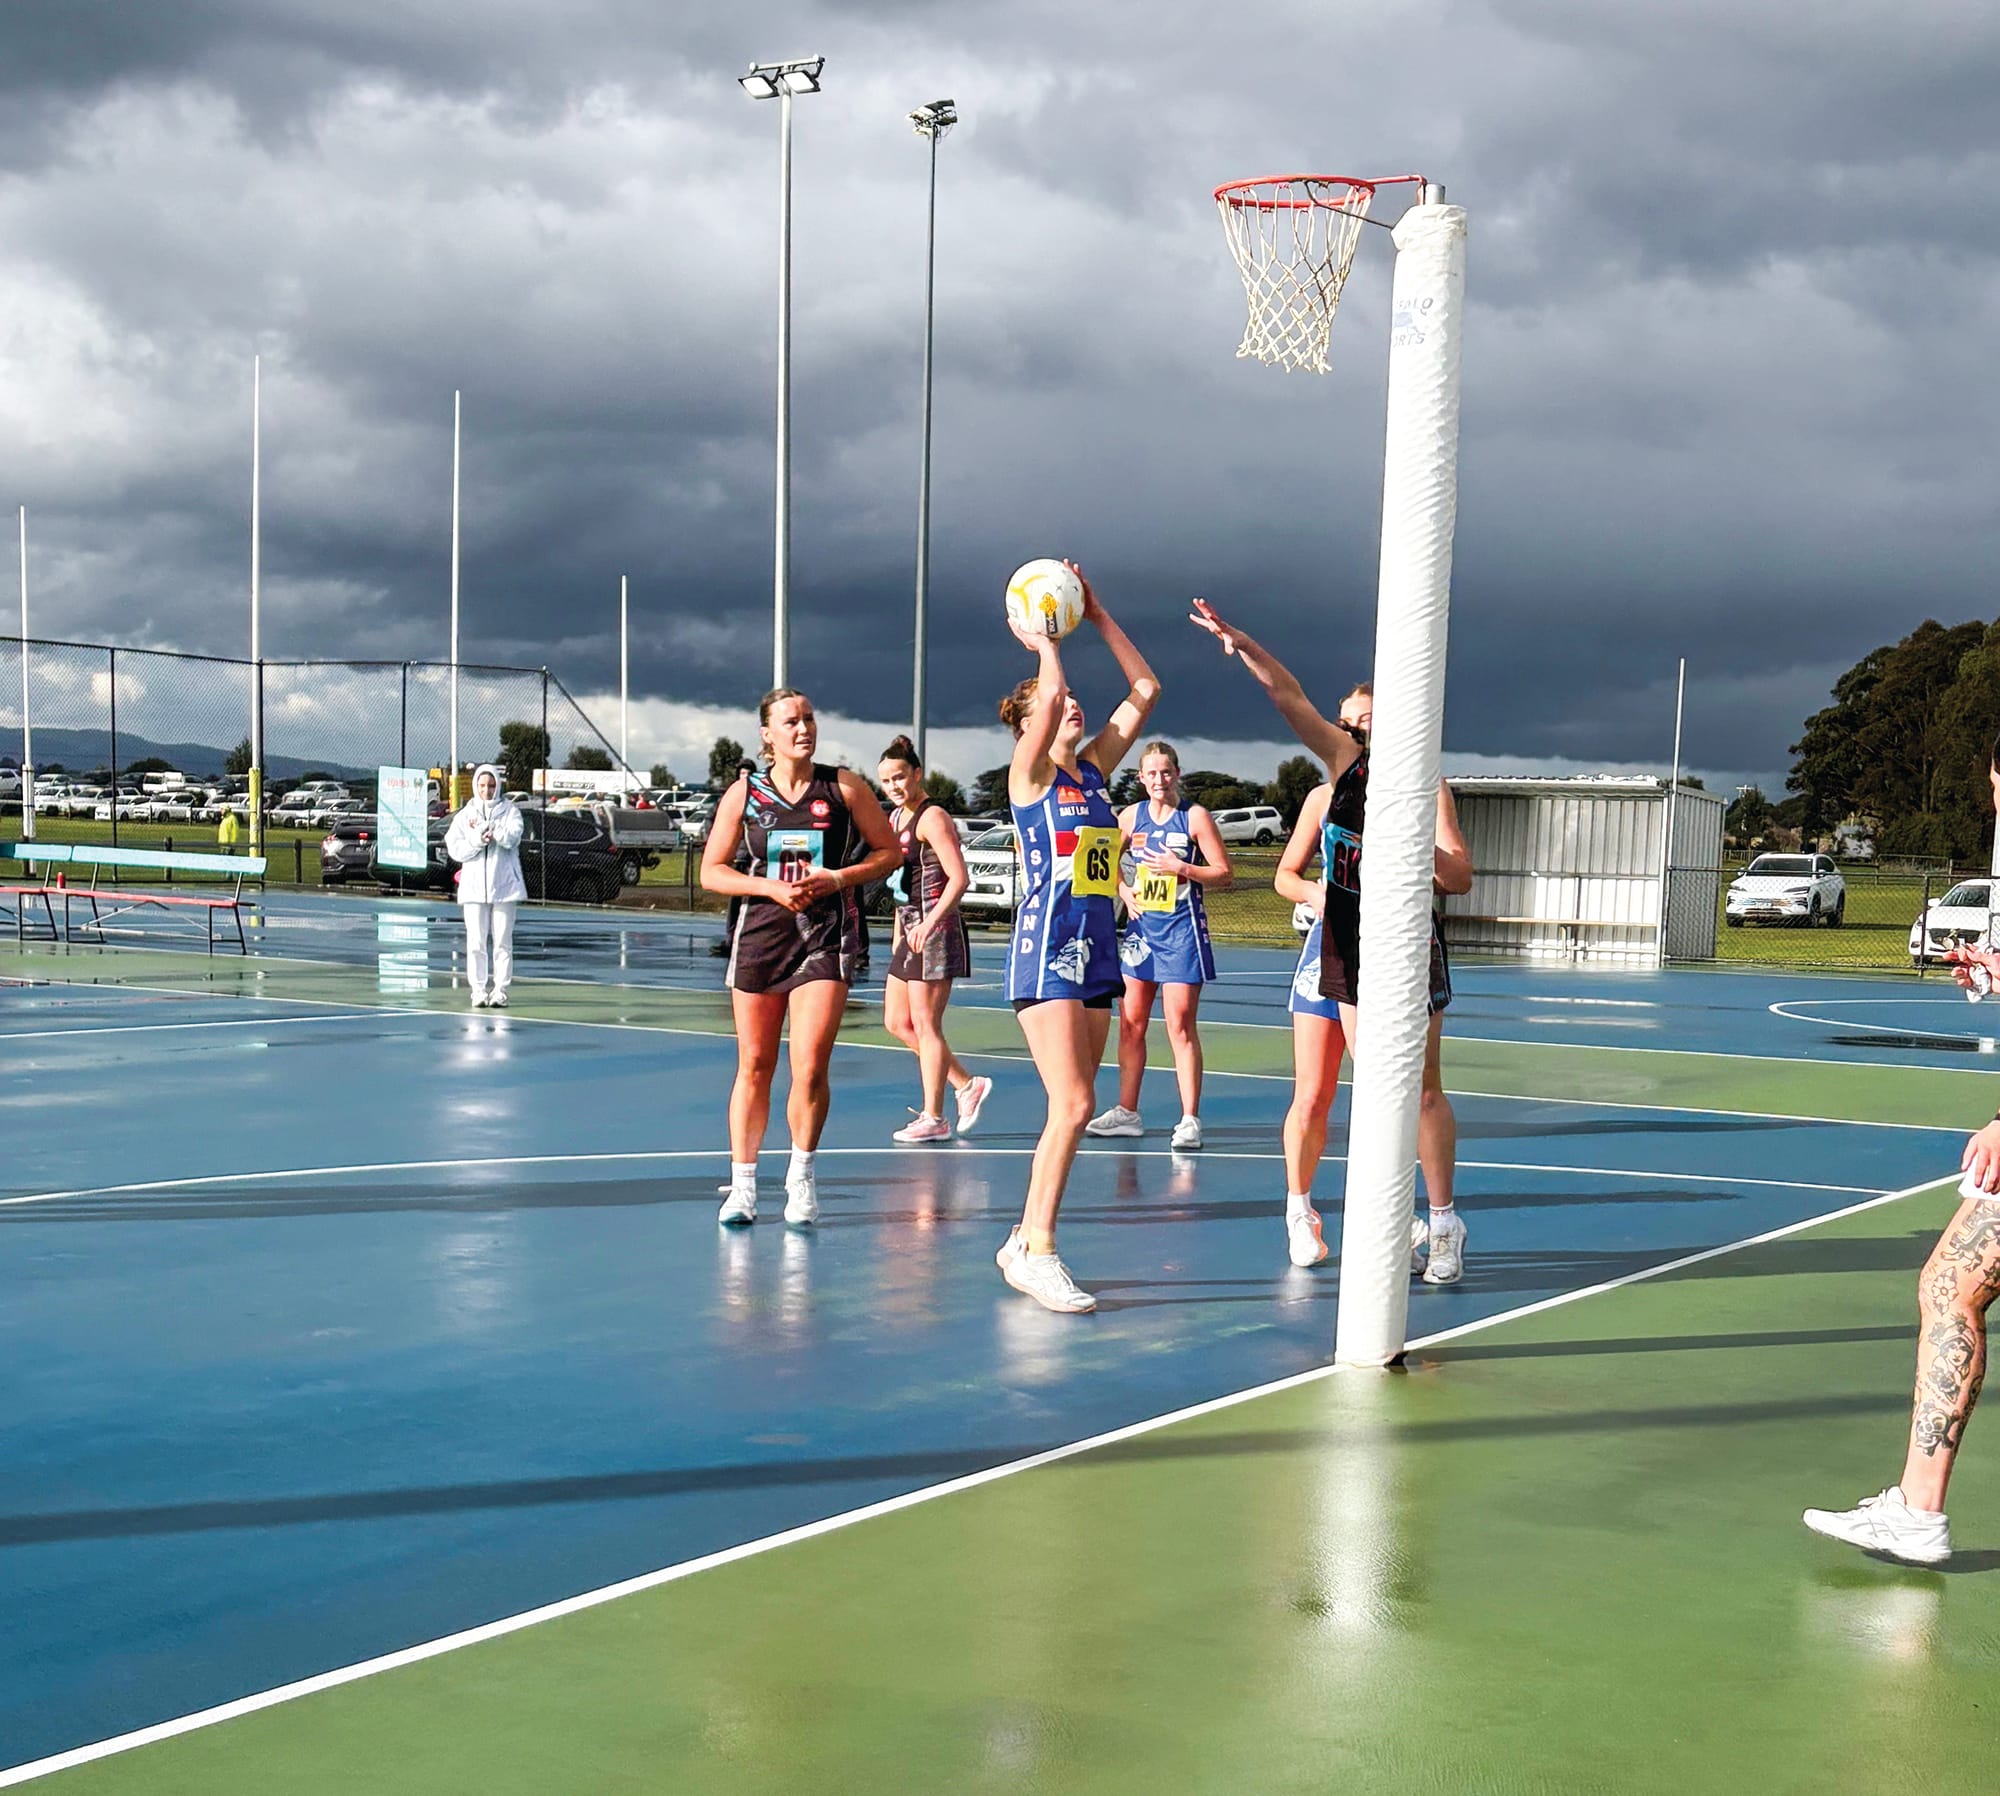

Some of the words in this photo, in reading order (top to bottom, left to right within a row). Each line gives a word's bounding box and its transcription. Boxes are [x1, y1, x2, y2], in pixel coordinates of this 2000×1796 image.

[1086, 847, 1110, 881] GS
[1021, 826, 1042, 954] ISLAND
[1143, 879, 1168, 901] WA
